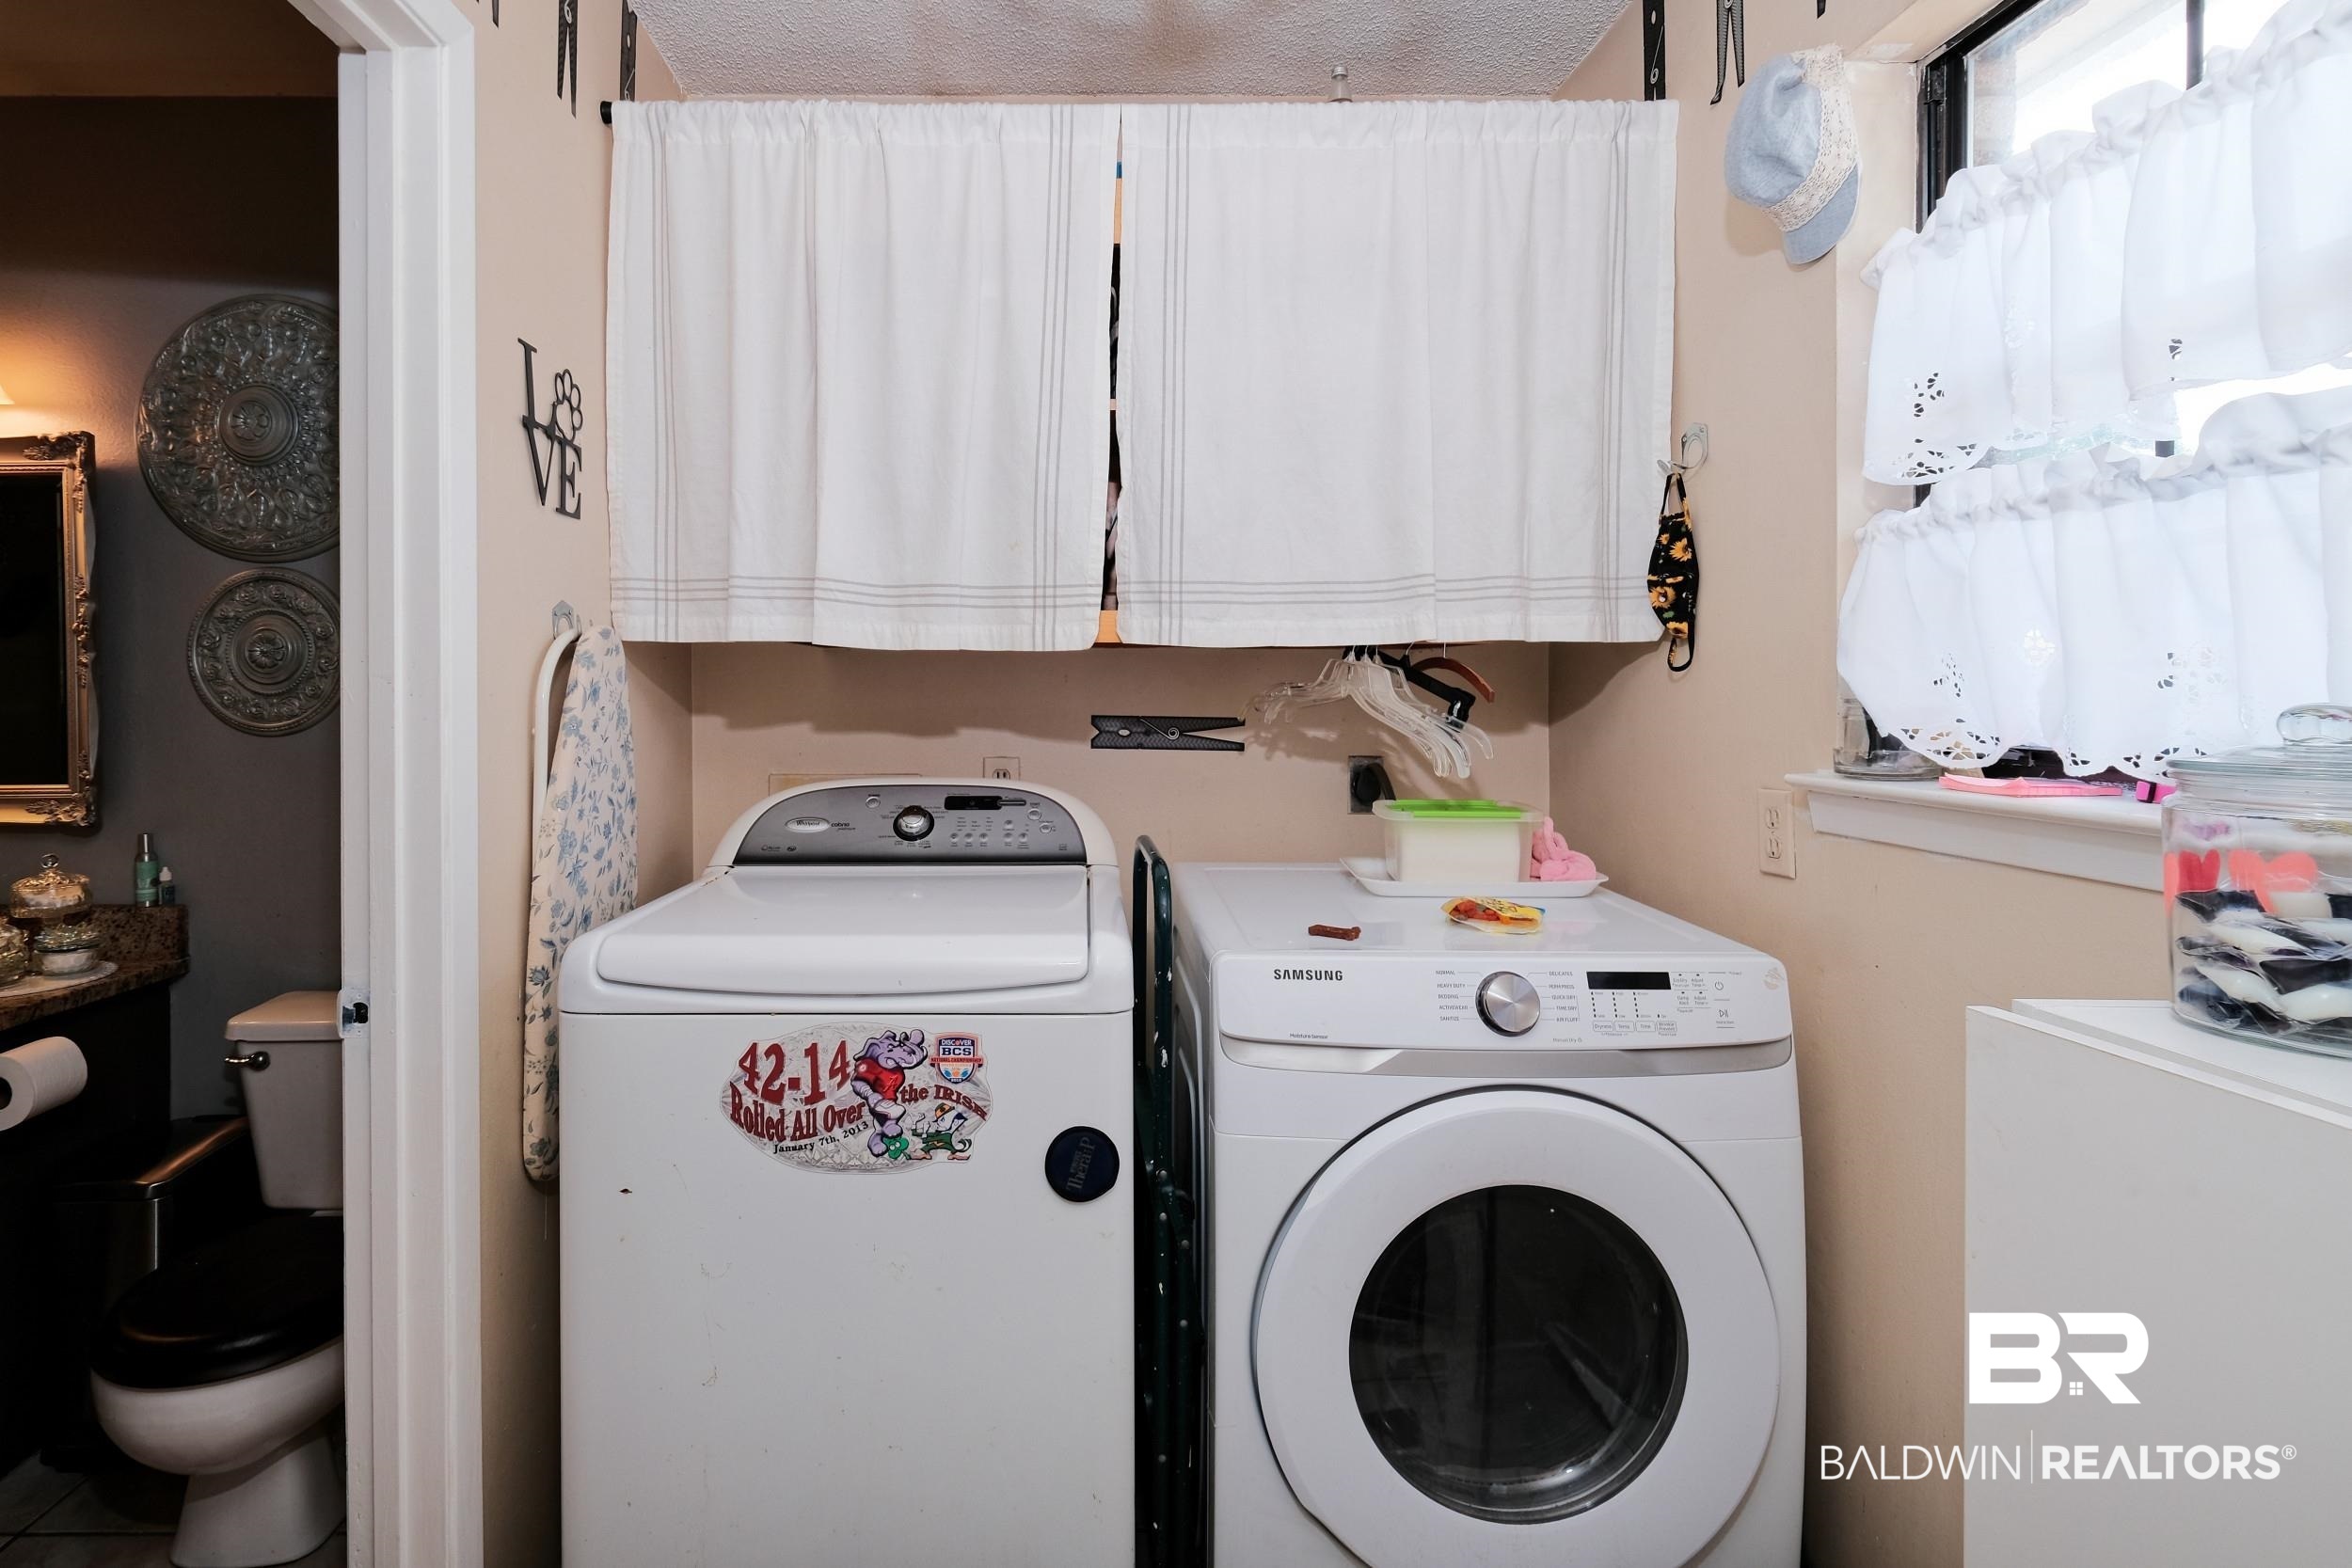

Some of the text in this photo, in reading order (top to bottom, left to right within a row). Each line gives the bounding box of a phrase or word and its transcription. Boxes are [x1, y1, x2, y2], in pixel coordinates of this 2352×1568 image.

[1273, 969, 1343, 981] SAMSUNG
[941, 1047, 972, 1055] BCS
[739, 1039, 850, 1106] 42-14
[730, 1081, 866, 1143] Rolled All Over
[900, 1084, 988, 1121] the IRISH
[773, 1121, 870, 1154] January 7th, 2013
